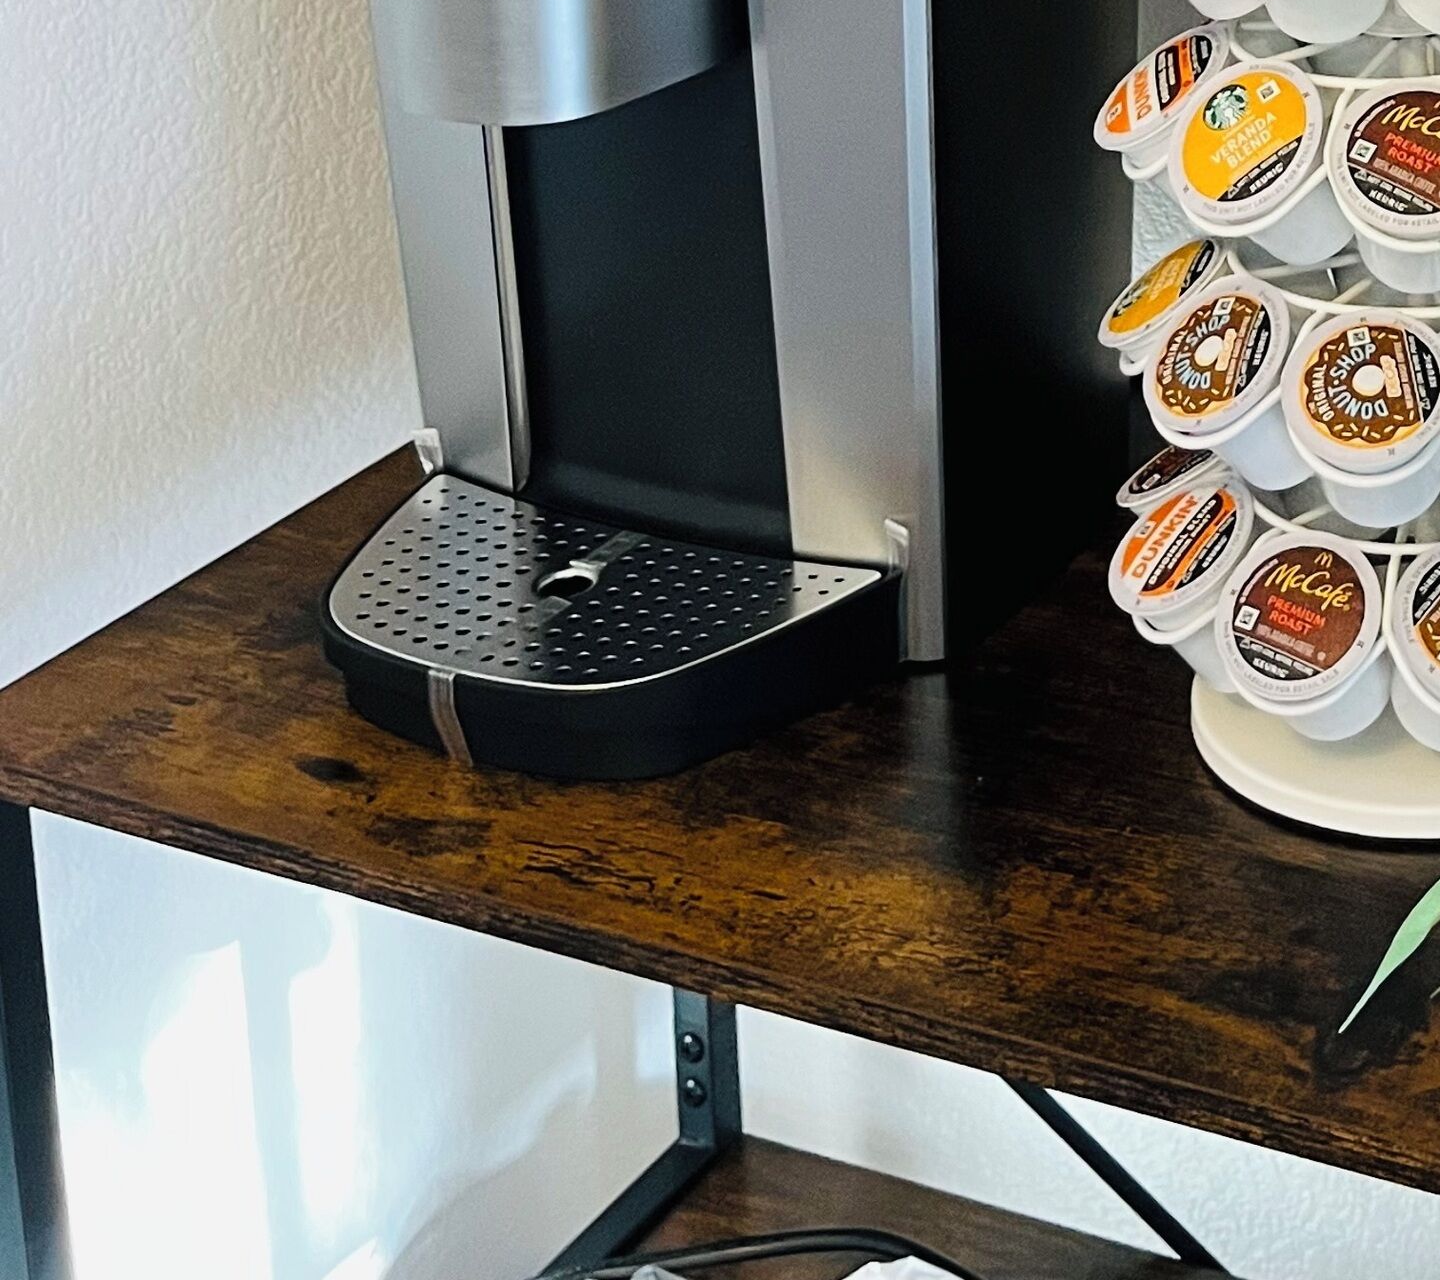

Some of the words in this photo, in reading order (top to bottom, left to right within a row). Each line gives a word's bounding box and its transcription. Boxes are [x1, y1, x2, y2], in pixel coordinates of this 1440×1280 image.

[1211, 112, 1277, 164] VERANDA
[1227, 130, 1272, 169] BLEND
[1387, 146, 1434, 173] ROAST
[1186, 314, 1231, 347] SHOP
[1162, 329, 1190, 385] ORIGINAL
[1174, 350, 1211, 389] DONUT
[1330, 344, 1377, 380] SHOP
[1311, 364, 1335, 422] ORIGINAL
[1328, 384, 1389, 420] DONUT
[1132, 495, 1199, 578] DUNKIN'
[1264, 563, 1354, 611] McCafé
[1267, 595, 1326, 628] PREMIUM
[1269, 611, 1313, 635] ROAST
